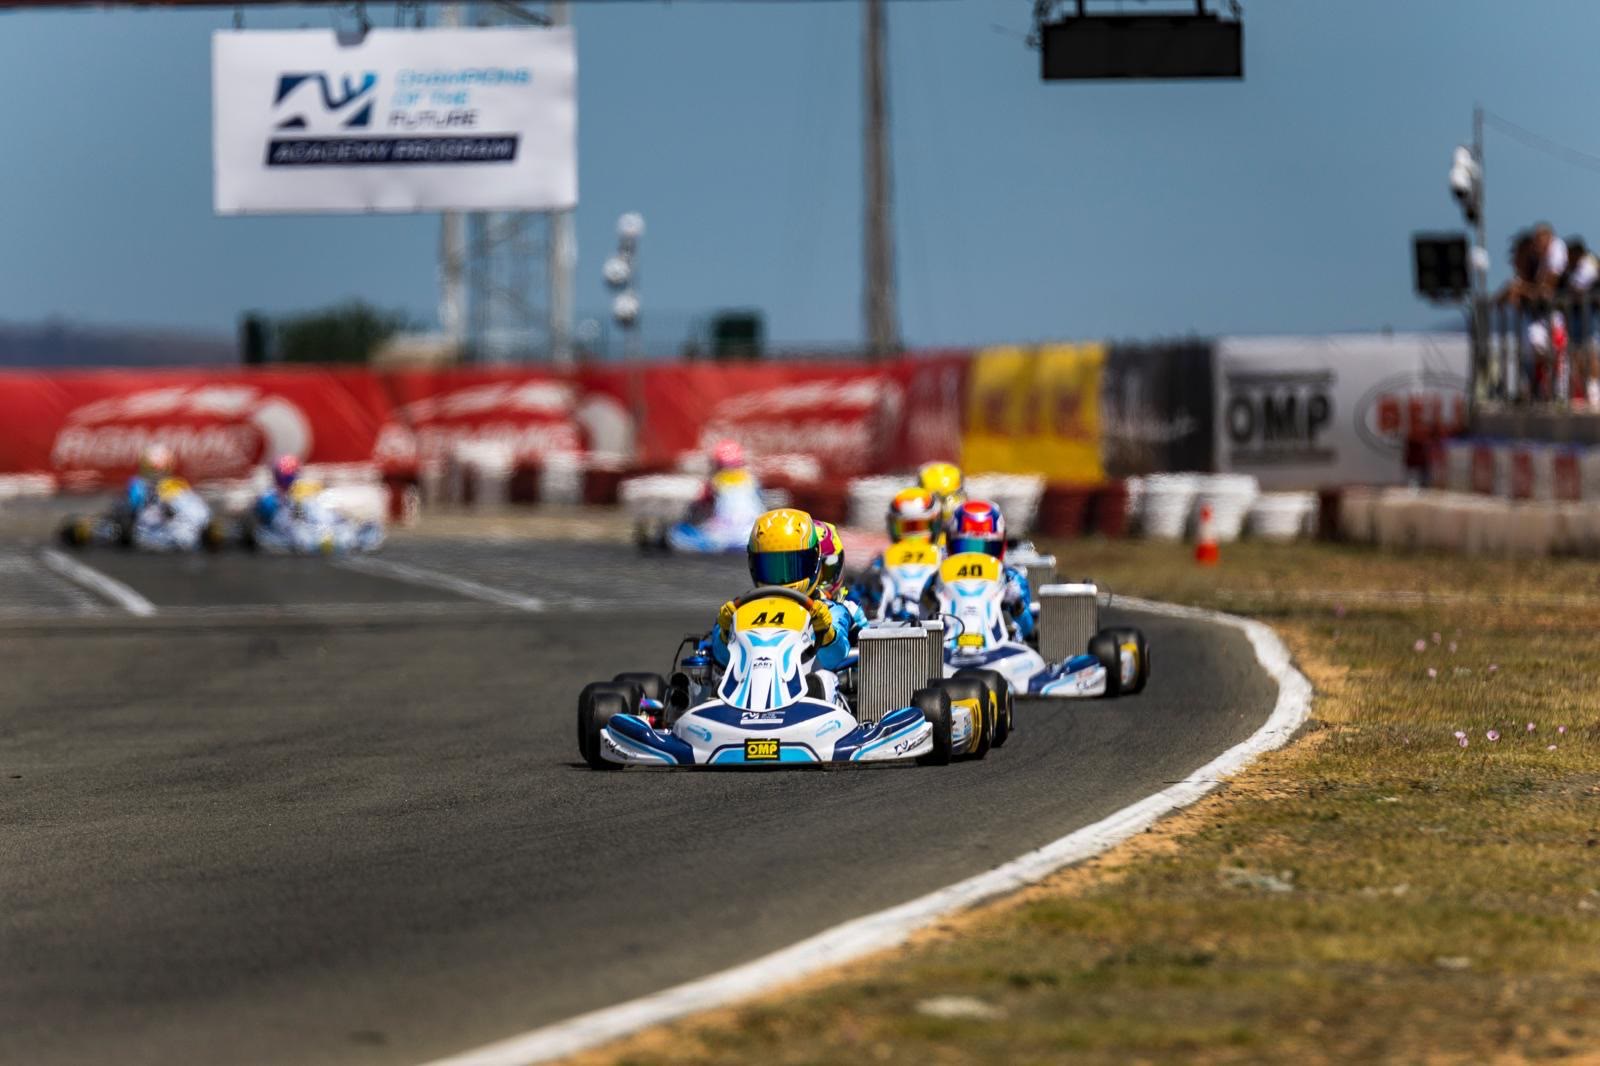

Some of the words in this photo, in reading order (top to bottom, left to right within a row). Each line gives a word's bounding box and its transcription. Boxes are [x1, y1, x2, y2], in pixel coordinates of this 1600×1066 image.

[388, 109, 479, 126] FUTURE
[274, 142, 390, 161] ACADEMY
[393, 140, 511, 160] PROGRAM
[1228, 395, 1330, 443] OMP
[957, 565, 983, 577] 40
[751, 611, 786, 625] 44
[747, 744, 778, 755] OMP
